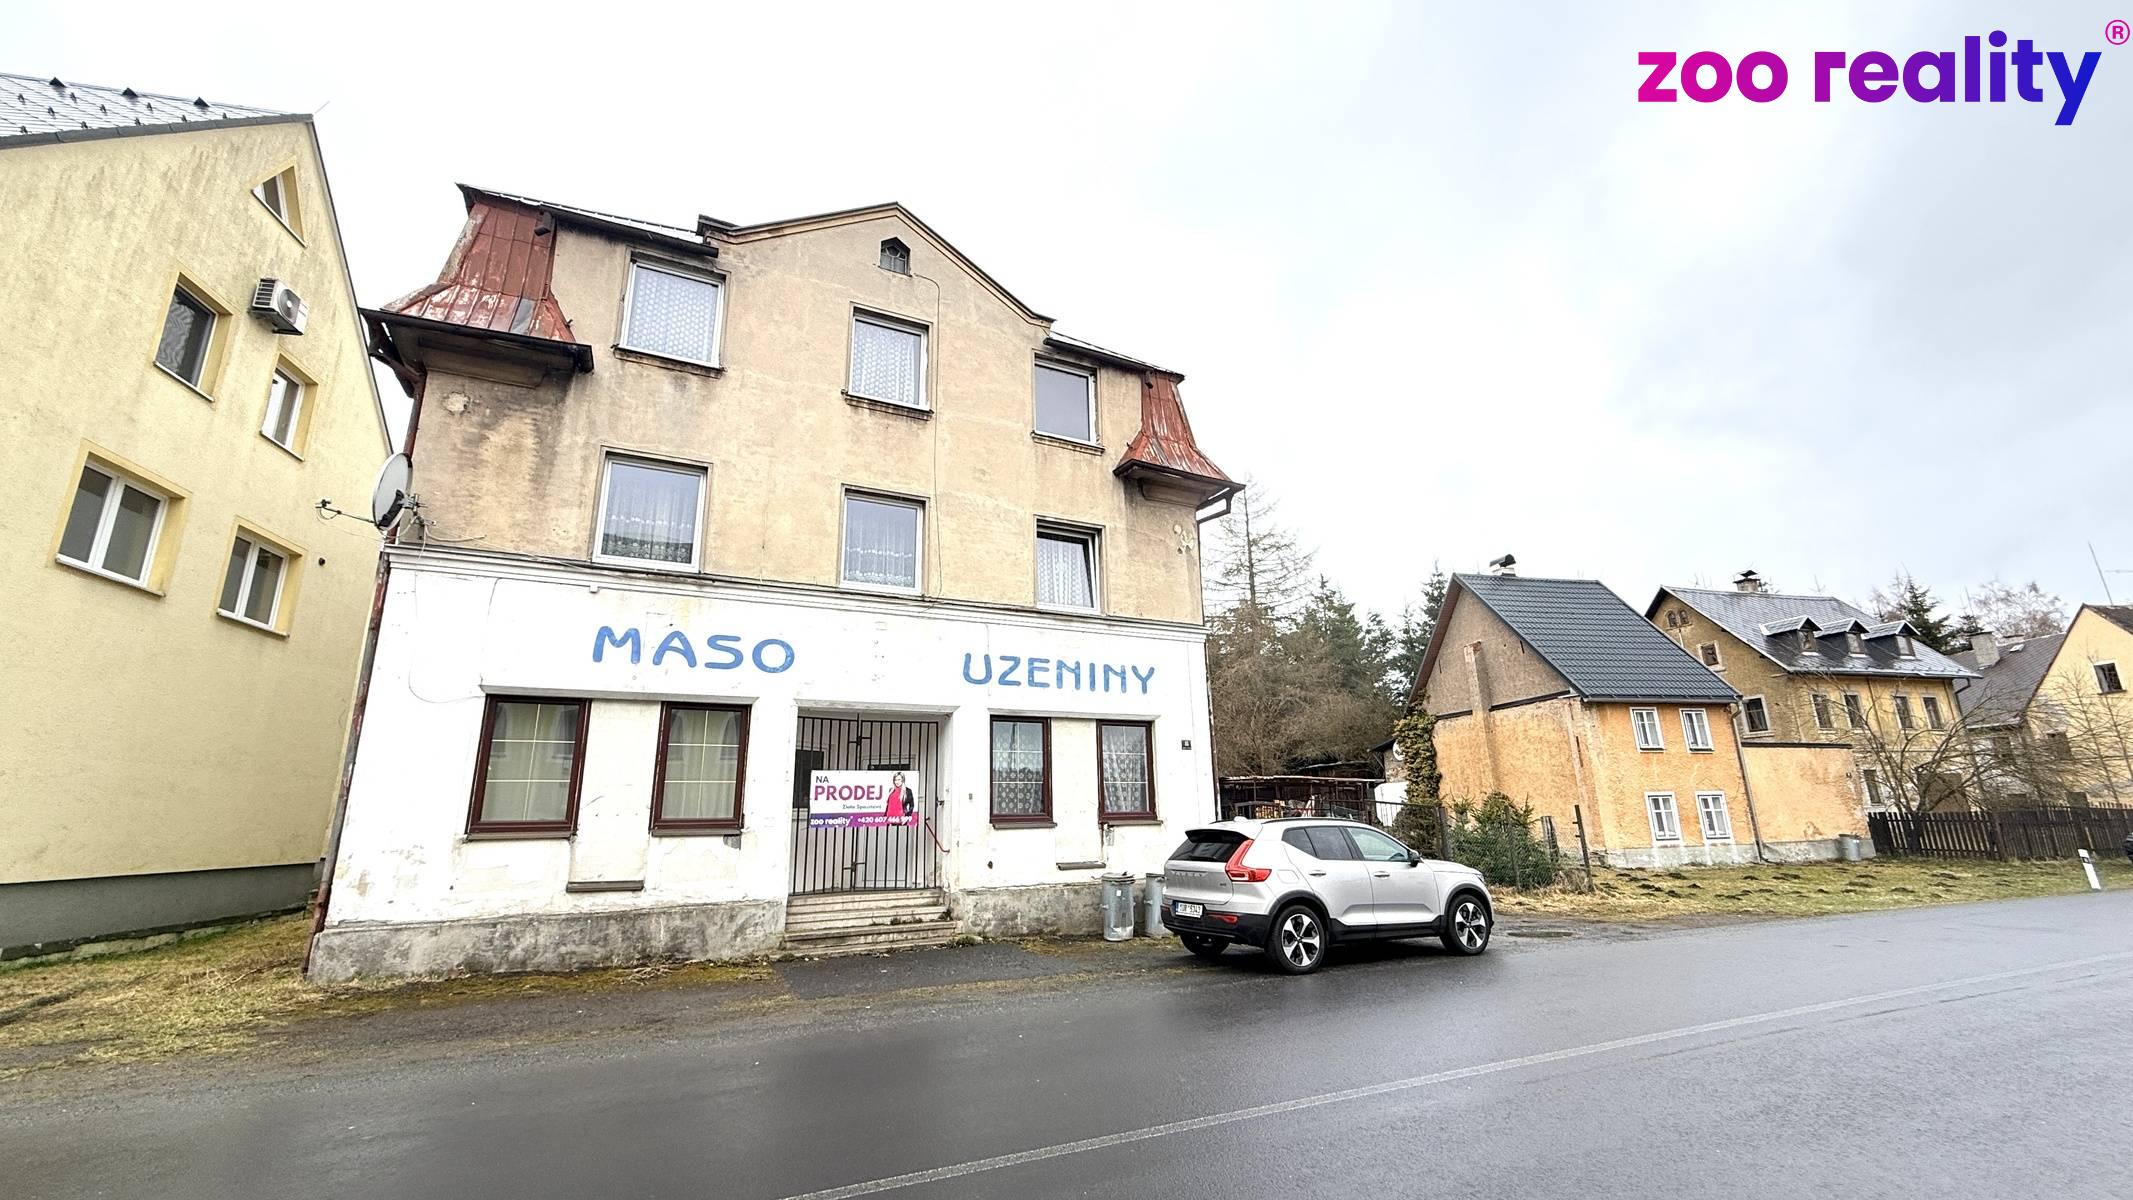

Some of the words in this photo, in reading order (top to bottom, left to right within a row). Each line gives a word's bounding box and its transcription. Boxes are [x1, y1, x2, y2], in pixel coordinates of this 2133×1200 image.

[592, 625, 795, 674] MASO
[962, 653, 1155, 694] UZENINY
[814, 785, 883, 801] PRODEJ
